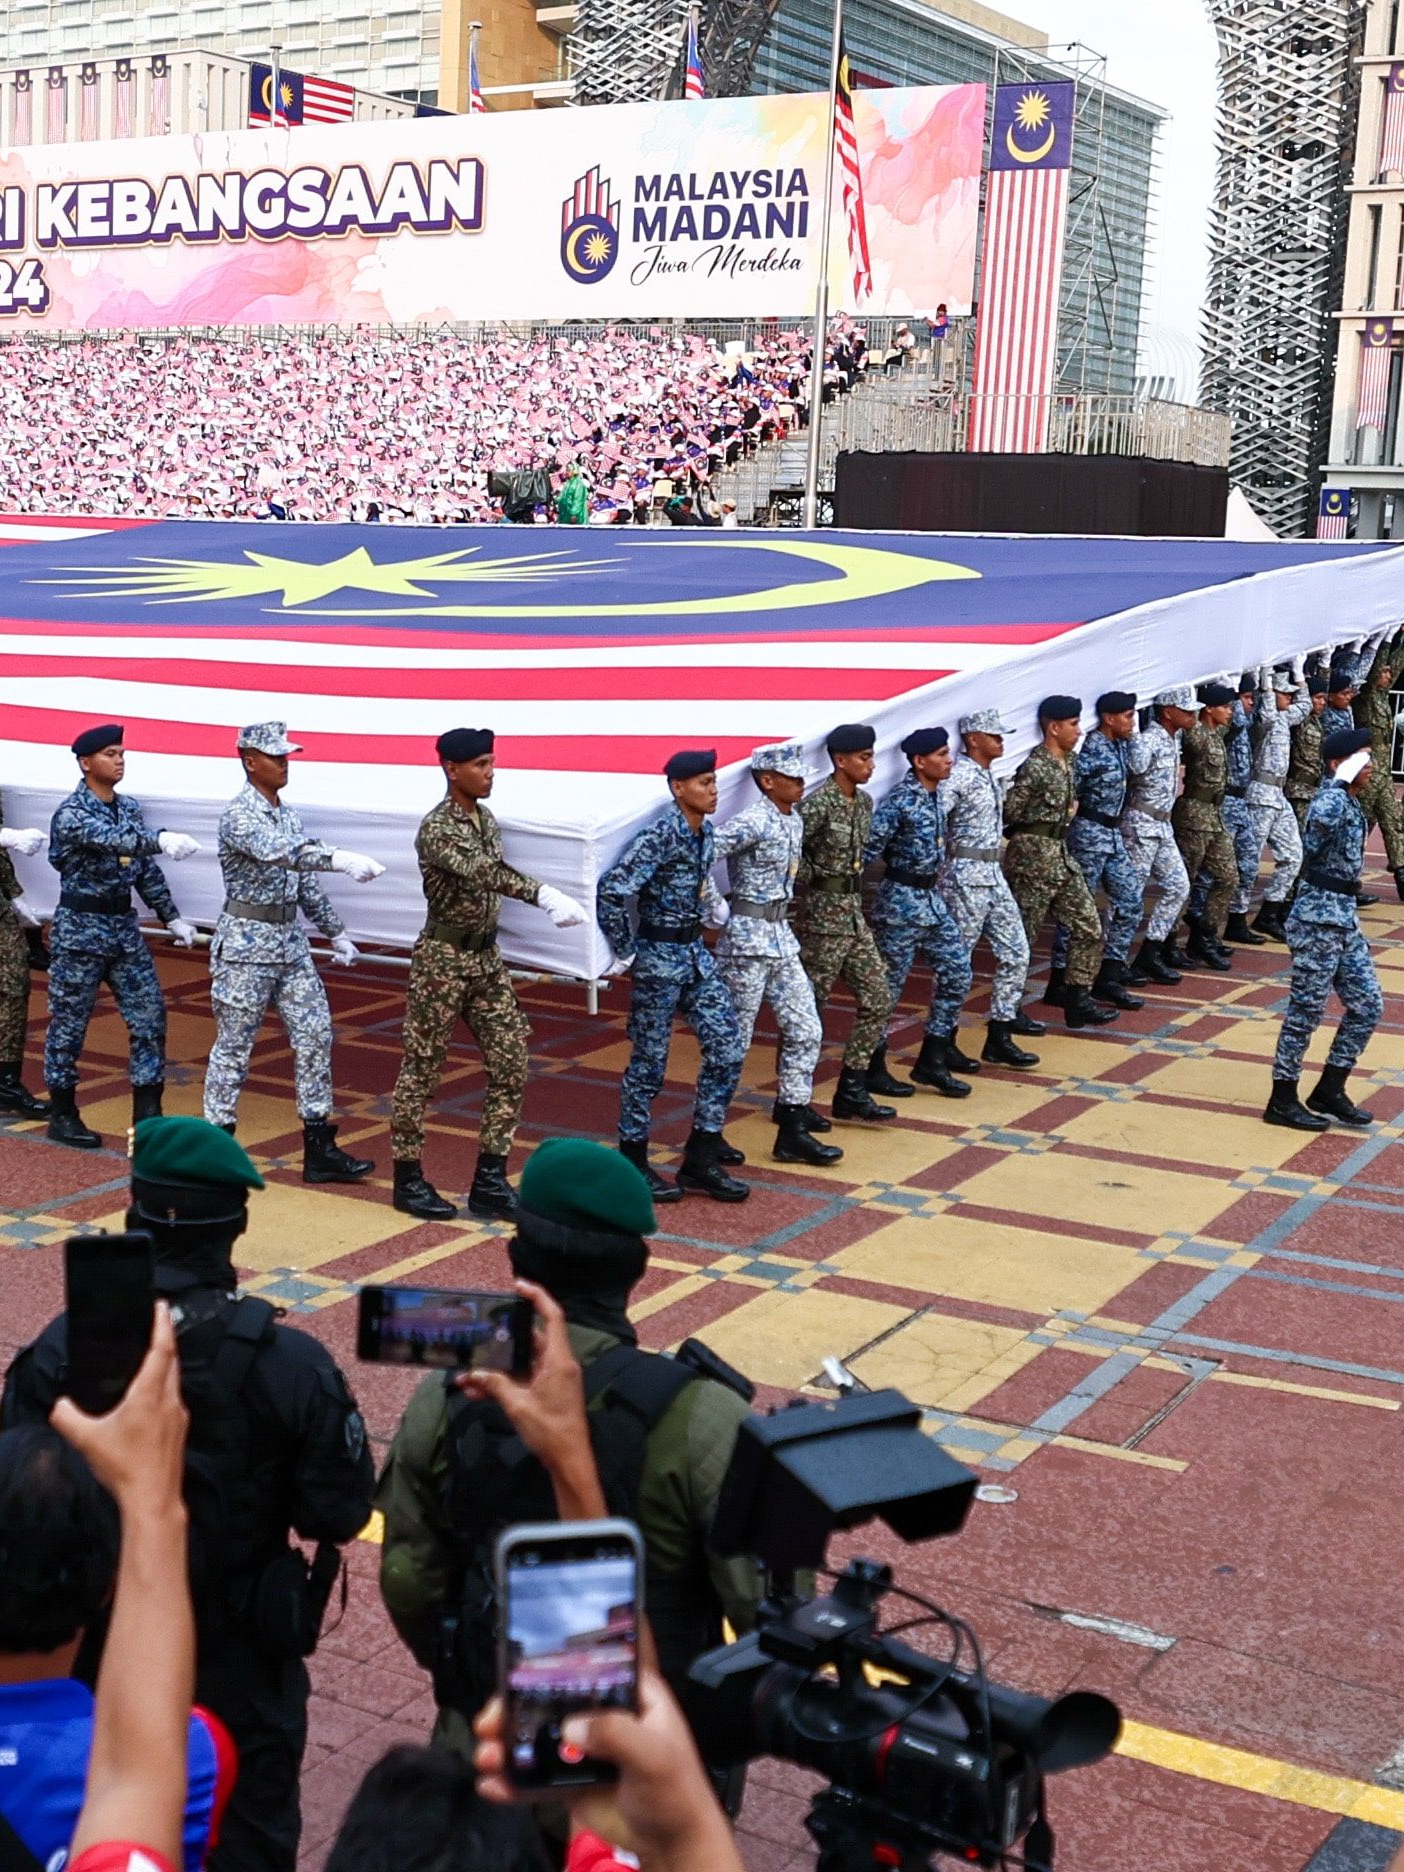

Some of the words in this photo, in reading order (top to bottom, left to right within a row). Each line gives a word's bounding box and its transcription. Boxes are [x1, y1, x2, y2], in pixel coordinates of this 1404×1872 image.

[37, 158, 485, 247] KEBANGSAAN
[634, 168, 809, 203] MALAYSIA
[632, 201, 809, 242] MADANI
[630, 244, 690, 286] Jiwa
[691, 243, 803, 279] Merdeka
